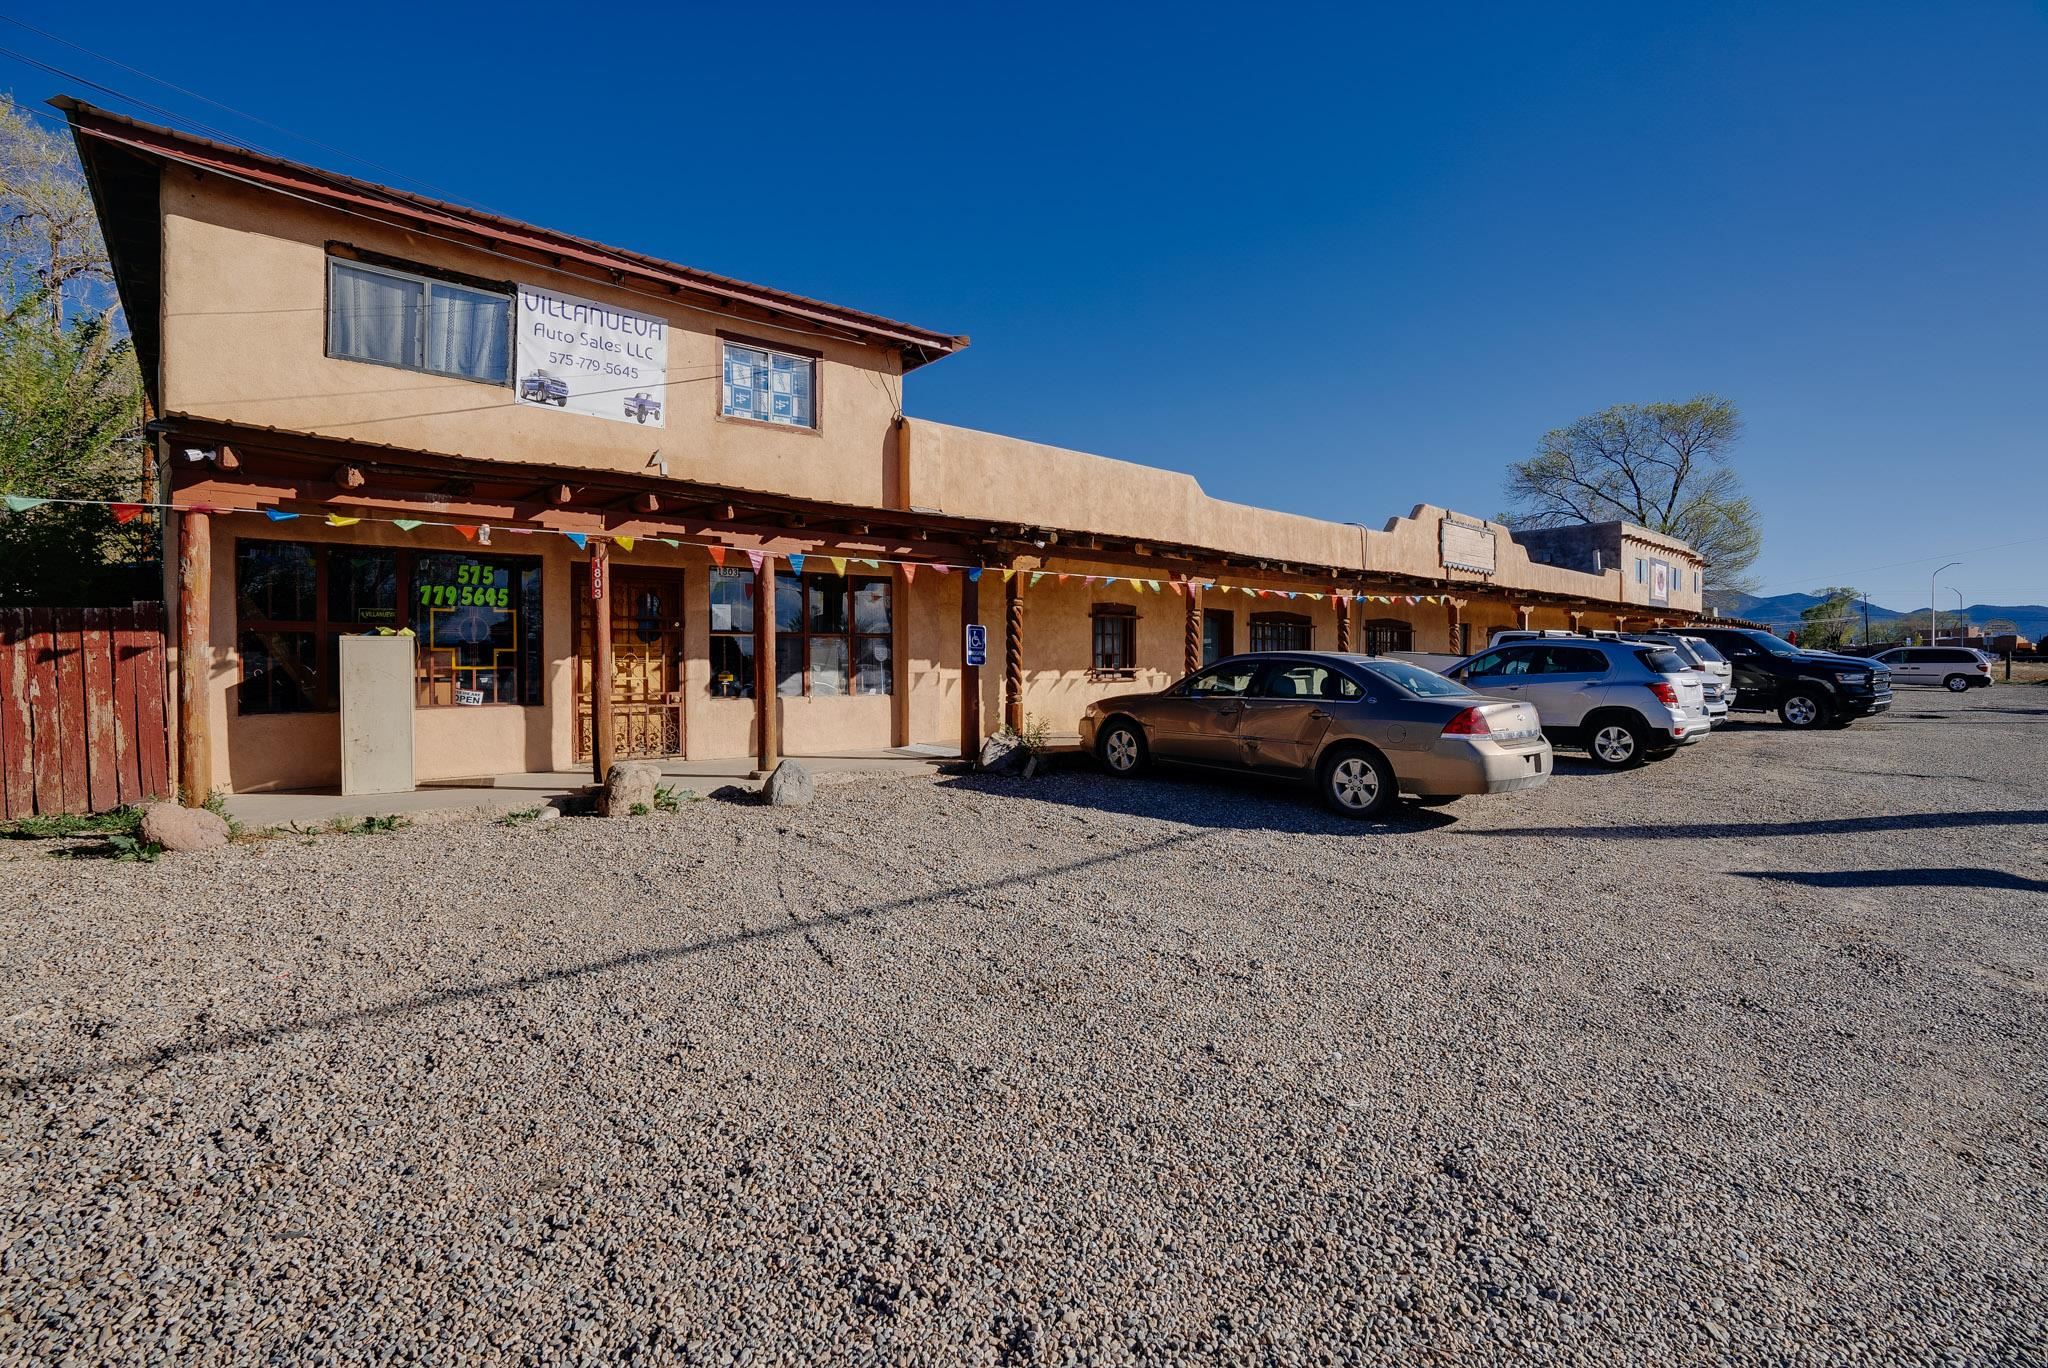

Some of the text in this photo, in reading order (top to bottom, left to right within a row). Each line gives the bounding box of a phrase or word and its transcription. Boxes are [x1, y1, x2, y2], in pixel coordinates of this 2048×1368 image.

[525, 292, 662, 340] VILLANUEVA
[534, 322, 653, 361] Auto Sales LLC
[458, 565, 494, 585] 575
[594, 558, 602, 599] 1803
[718, 568, 738, 576] 1803
